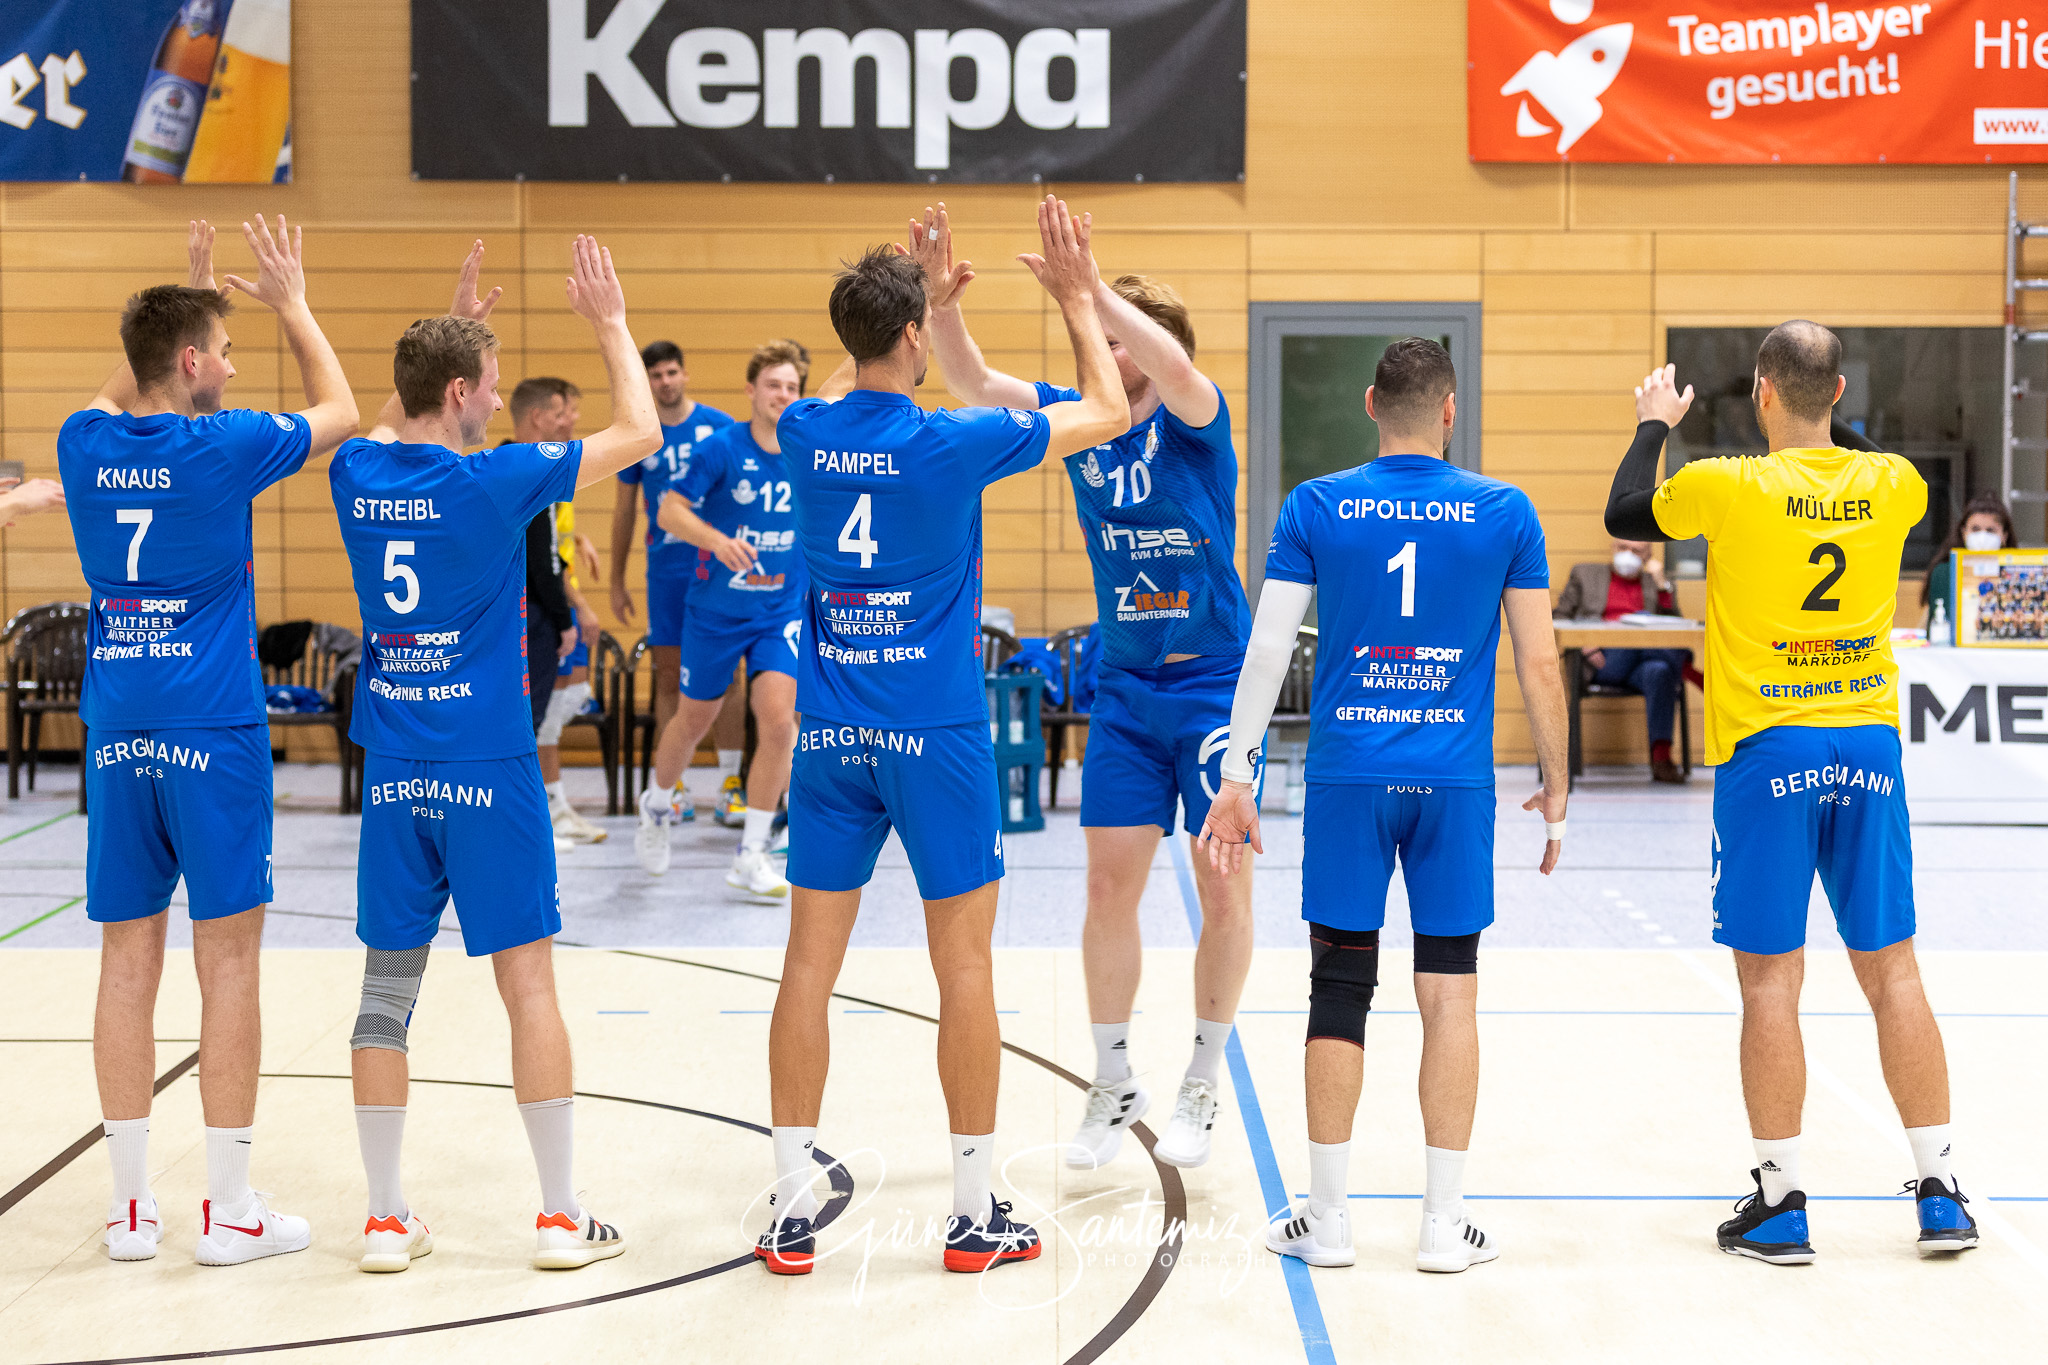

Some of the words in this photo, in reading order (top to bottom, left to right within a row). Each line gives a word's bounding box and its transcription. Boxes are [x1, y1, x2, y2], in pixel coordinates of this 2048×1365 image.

[1667, 2, 1932, 57] Teamplayer
[548, 0, 1111, 170] Kempa
[1706, 52, 1901, 120] gesucht!
[813, 449, 900, 475] PAMPEL
[96, 466, 171, 489] KNAUS
[1107, 459, 1152, 507] 10
[759, 480, 791, 513] 12
[352, 497, 441, 521] STREIBL
[1338, 498, 1476, 523] CIPOLLONE
[1786, 495, 1873, 522] MÜLLER
[838, 493, 878, 569] 4
[116, 508, 153, 582] 7
[1130, 551, 1151, 561] KVM
[1154, 549, 1163, 558] &
[1164, 546, 1195, 557] Beyond
[383, 540, 420, 614] 5
[1386, 541, 1417, 617] 1
[1800, 542, 1847, 612] 2
[107, 598, 188, 613] INTERSPORT
[829, 591, 912, 606] INTERSPORT
[107, 615, 174, 628] RAITHER
[830, 608, 897, 622] RAITHER
[106, 628, 169, 643] MARKDOR
[378, 631, 460, 646] INTERSPORT
[832, 621, 904, 636] MARKDORF
[149, 642, 193, 658] RECK
[380, 647, 444, 659] RAITHER
[883, 646, 927, 663] RECK
[1369, 645, 1463, 662] INTERSPORT
[1790, 635, 1877, 653] INTERSPORT
[381, 660, 450, 673] MARKDORF
[1369, 663, 1447, 677] RAITHER
[1787, 653, 1871, 667] MARKDORF
[428, 682, 472, 701] RECK
[1362, 676, 1450, 692] MARKDORF
[1759, 681, 1843, 698] GETRÄNKE
[1849, 673, 1887, 693] RECK
[1335, 706, 1422, 724] GETRÄNKE
[1424, 708, 1466, 725] RECK
[801, 726, 924, 757] BERGMANN
[1770, 763, 1895, 798] BERGMANN
[993, 829, 1002, 860] 4
